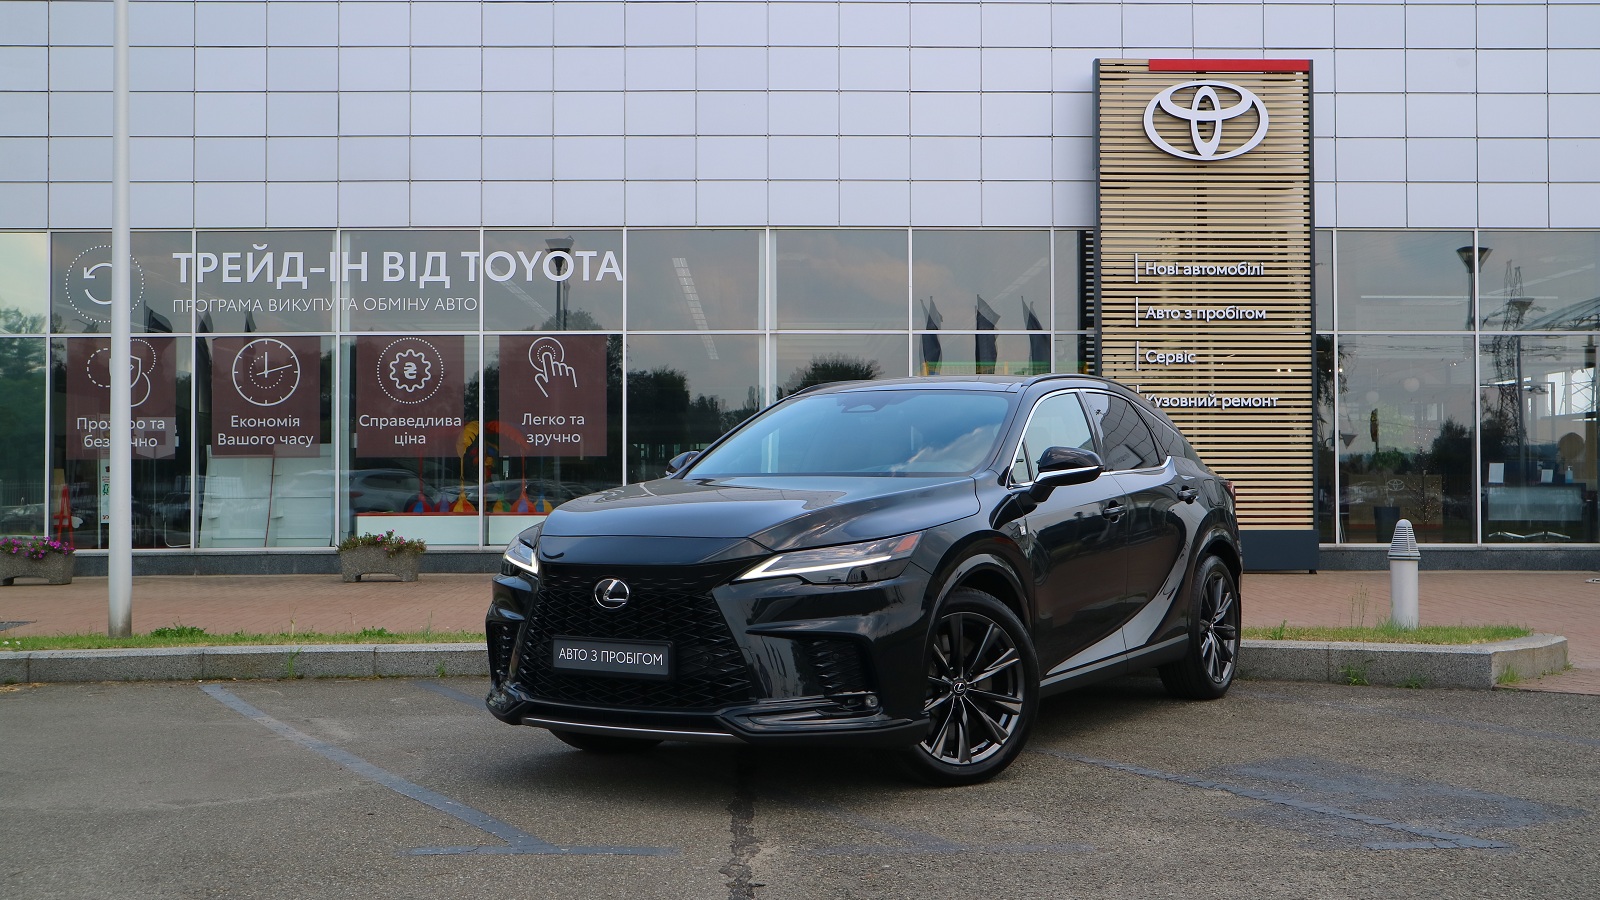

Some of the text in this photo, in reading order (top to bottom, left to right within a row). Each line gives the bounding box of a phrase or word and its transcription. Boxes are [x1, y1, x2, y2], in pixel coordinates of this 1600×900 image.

[172, 243, 623, 290] ТРЕЙД-ІН ВІД TOYOTA
[1145, 262, 1265, 276] Нові автомобілі
[173, 297, 478, 313] ПРОГРАМА ВИКУПУ ТА ОБМІНУ АВТО
[1145, 305, 1267, 323] Авто з пробігом
[1145, 350, 1197, 366] Сервіс
[1221, 397, 1279, 410] ремонт
[76, 417, 166, 433] Проо та
[231, 415, 300, 428] Економія
[359, 414, 462, 430] Справедлива
[521, 412, 585, 426] Легко та
[83, 434, 158, 448] безчно
[217, 432, 314, 448] Вашого часу
[394, 431, 427, 447] ціна
[526, 432, 581, 446] зручно
[558, 647, 588, 661] АВТО
[600, 650, 663, 666] ПРОБІГОМ
